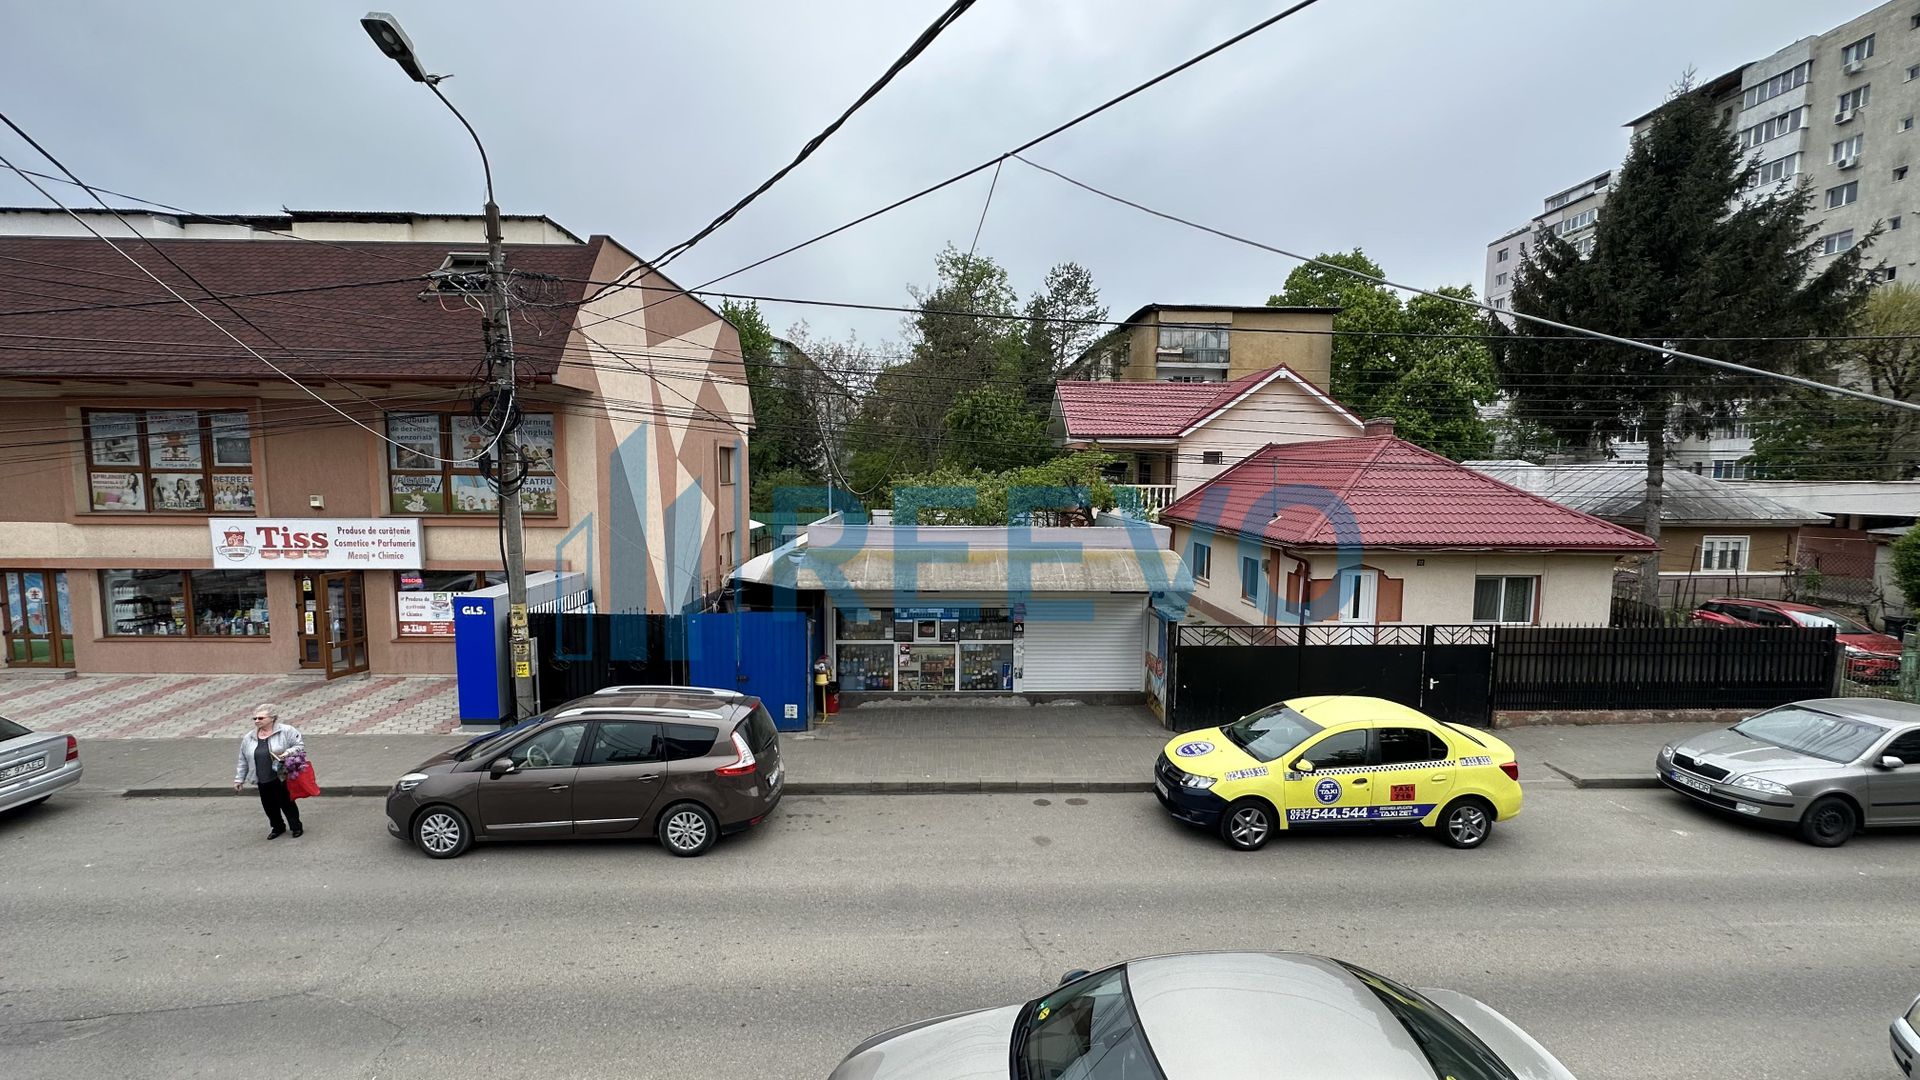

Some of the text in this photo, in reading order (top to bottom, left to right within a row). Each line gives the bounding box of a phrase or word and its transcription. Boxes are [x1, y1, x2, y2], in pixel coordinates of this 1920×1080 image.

[522, 478, 552, 486] EATRU
[337, 526, 366, 535] Produse
[368, 526, 377, 535] de
[256, 526, 329, 548] Tiss
[334, 538, 416, 547] Cosmetice Parfumerie
[347, 551, 404, 561] Menaj Chimice
[1311, 807, 1368, 819] 544.544
